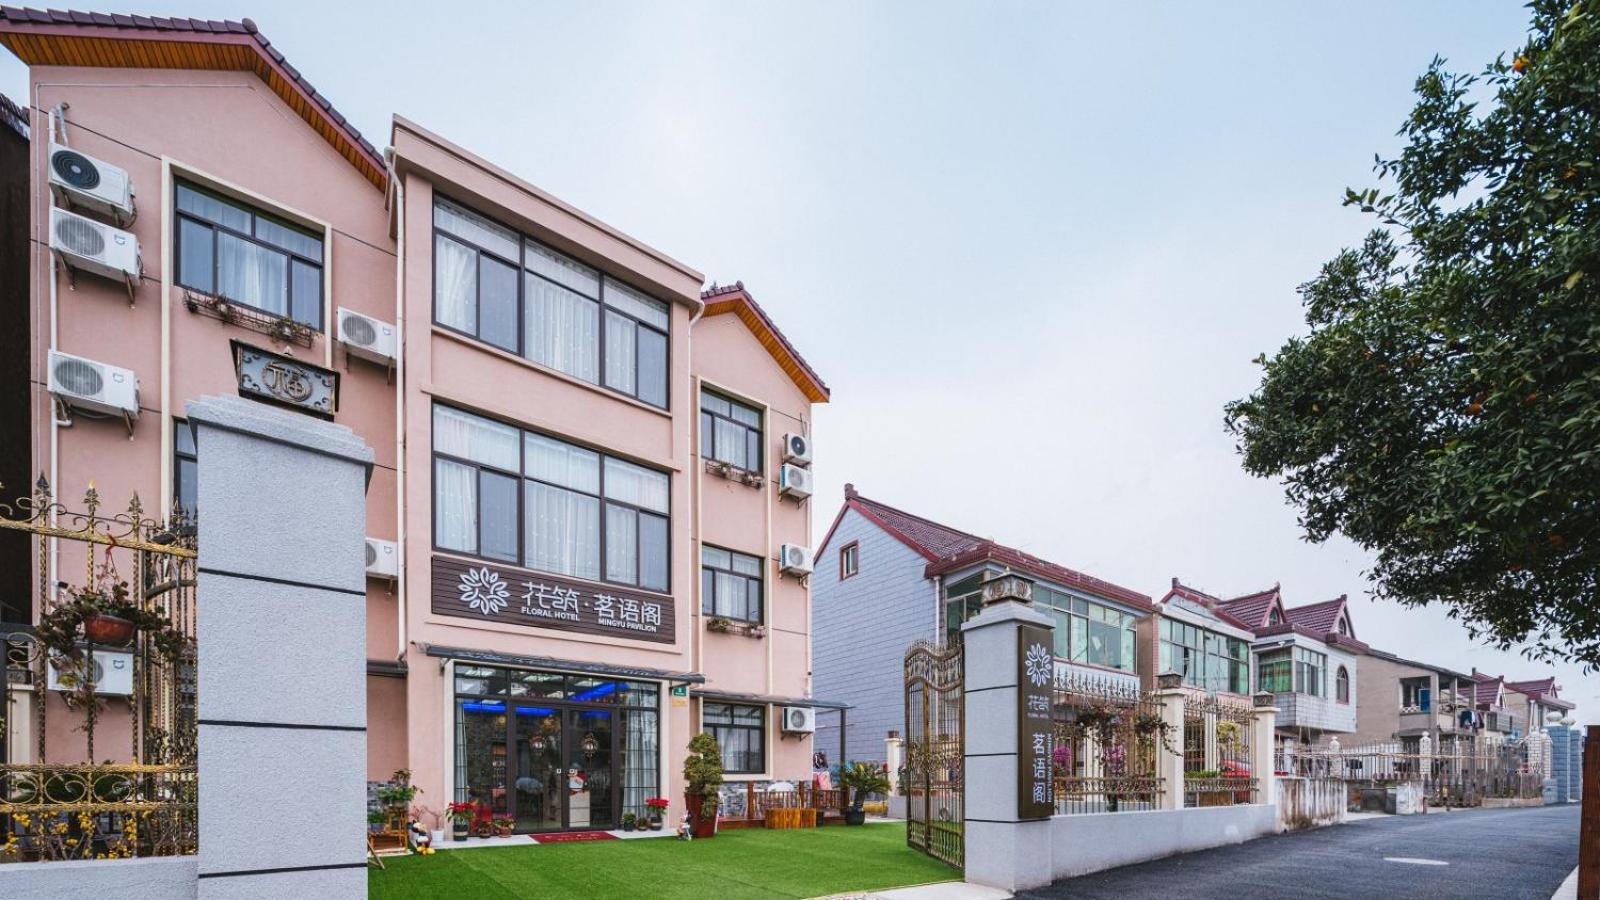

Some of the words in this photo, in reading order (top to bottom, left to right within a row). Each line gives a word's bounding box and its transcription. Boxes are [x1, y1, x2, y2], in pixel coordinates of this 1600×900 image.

[521, 606, 553, 618] FLORAL
[554, 611, 580, 621] HOTEL
[598, 618, 626, 628] MINGYU
[626, 622, 657, 633] PAVILION
[1032, 733, 1045, 804] 茗语阁
